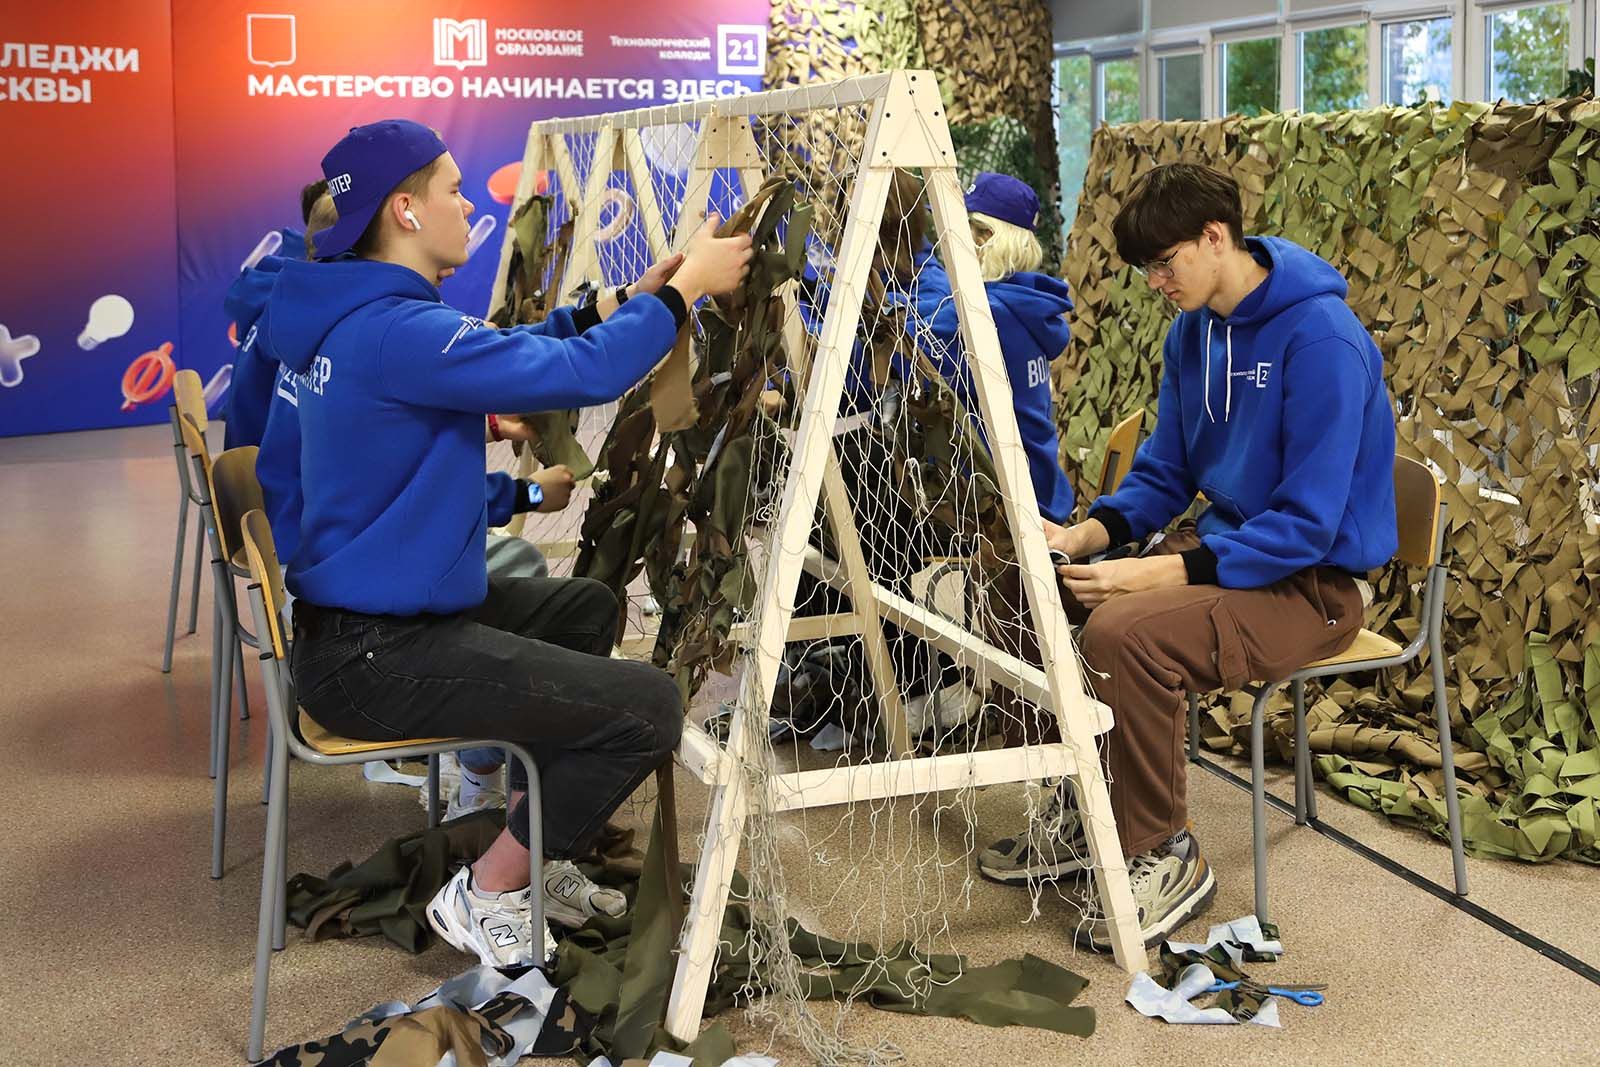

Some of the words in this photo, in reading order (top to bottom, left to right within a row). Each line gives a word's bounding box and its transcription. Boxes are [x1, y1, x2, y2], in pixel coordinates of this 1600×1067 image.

[495, 28, 584, 42] МОСКОВСКОЕ
[609, 36, 711, 48] Технологический
[0, 42, 140, 74] ЛЕДЖИ
[495, 43, 584, 57] ОБРАЗОВАНИЕ
[659, 50, 711, 61] колледж
[728, 39, 757, 61] 21
[248, 74, 454, 98] МАСТЕРСТВО
[462, 76, 655, 100] НАЧИНАЕТСЯ
[661, 79, 752, 102] ЗДЕСЬ
[553, 875, 580, 899] N
[489, 924, 518, 948] N
